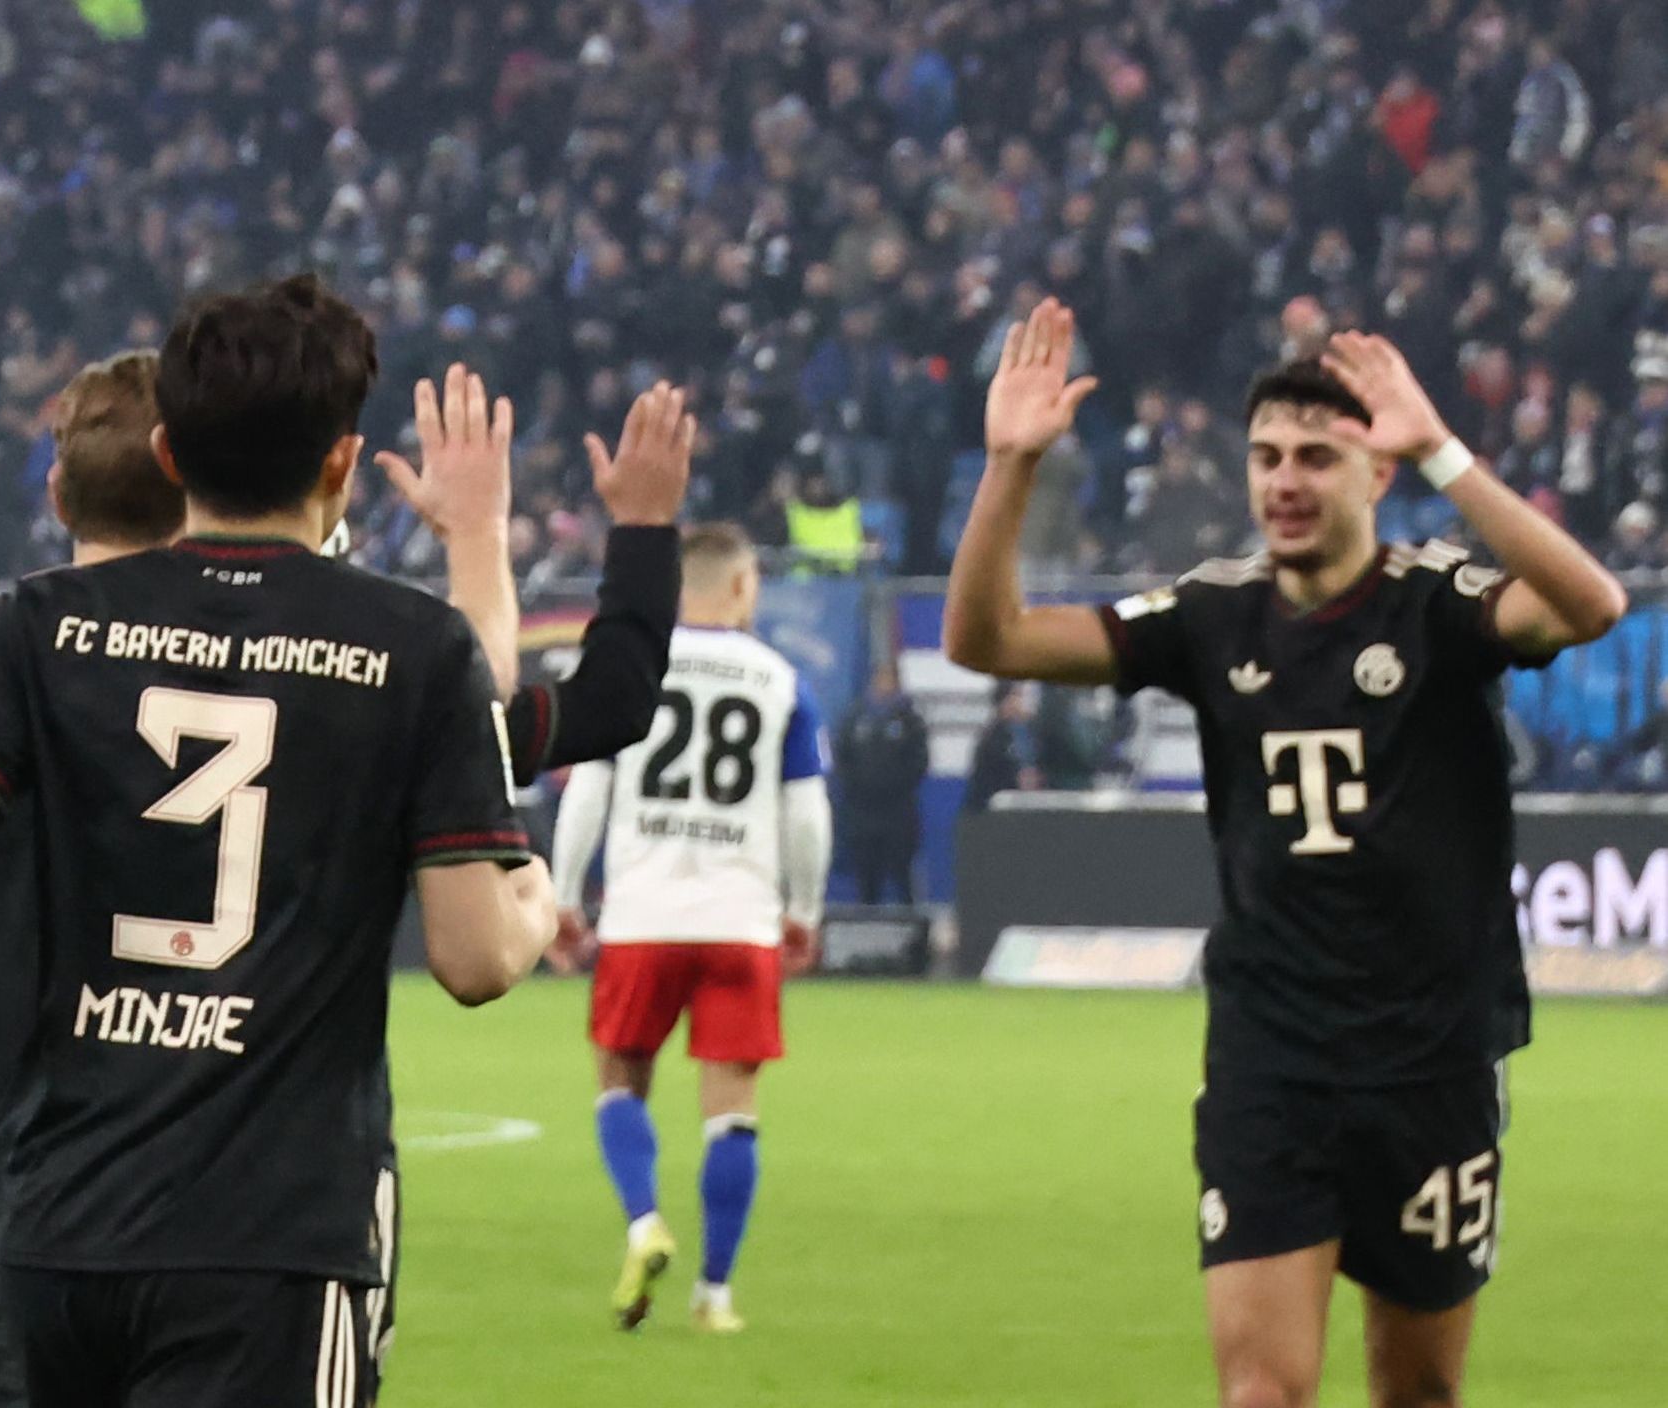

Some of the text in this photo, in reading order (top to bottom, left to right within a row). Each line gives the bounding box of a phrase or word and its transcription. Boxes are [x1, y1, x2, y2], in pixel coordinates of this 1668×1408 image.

[55, 615, 390, 688] FC BAYERN MÜNCHEN
[637, 688, 762, 806] 28
[111, 685, 279, 971] 3
[72, 982, 255, 1055] MINJAE
[1400, 1149, 1496, 1250] 45
